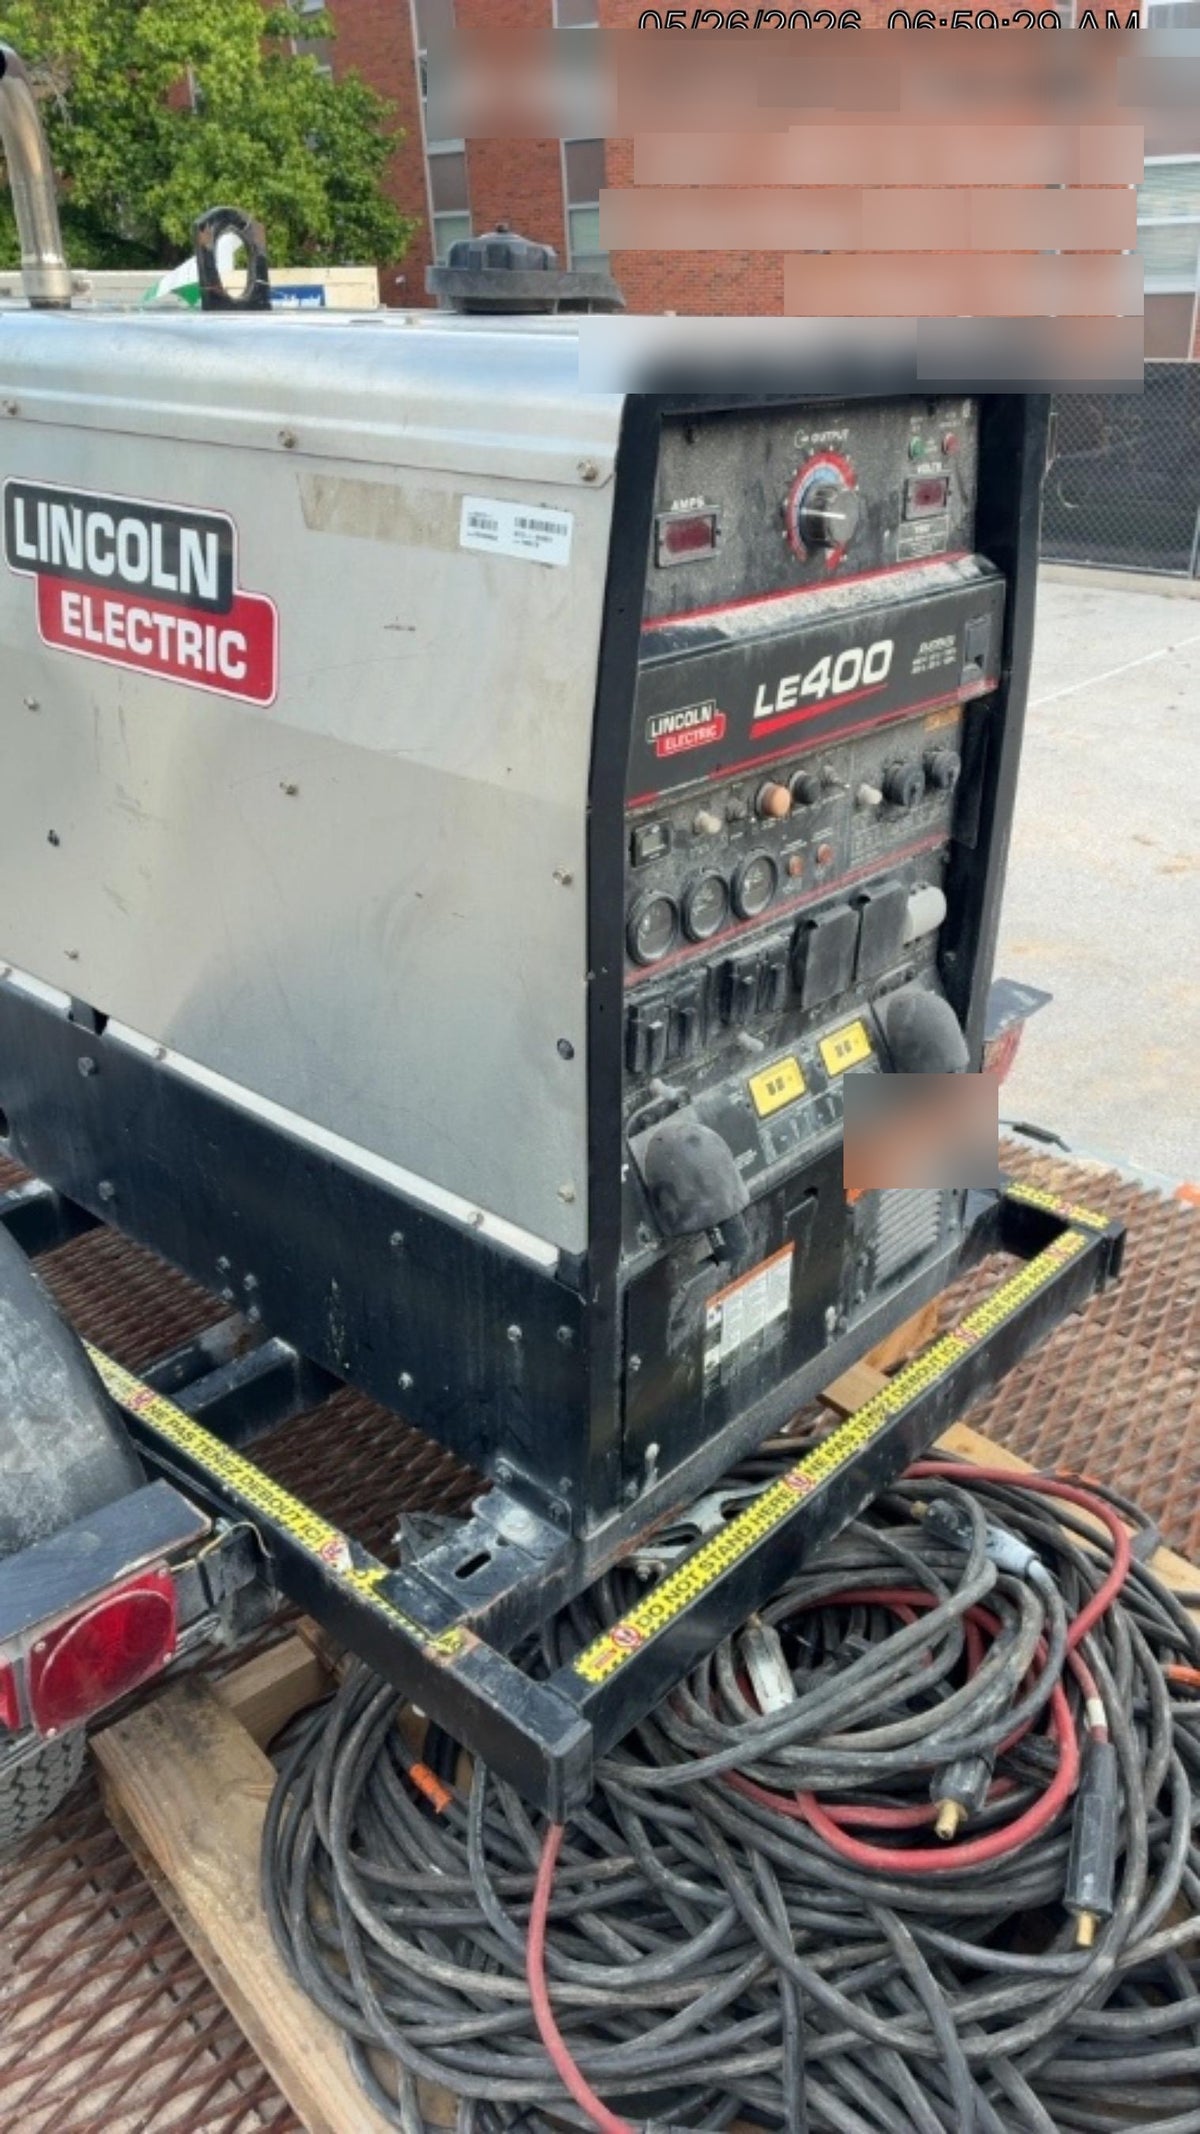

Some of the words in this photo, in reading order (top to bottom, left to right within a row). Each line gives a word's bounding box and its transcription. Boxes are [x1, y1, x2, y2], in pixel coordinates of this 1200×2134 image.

[670, 495, 705, 511] AMPS
[13, 496, 220, 600] LINCOLN
[60, 589, 247, 680] ELECTRIC
[651, 704, 713, 739] LINCOLN
[753, 639, 895, 719] LE400
[665, 724, 718, 751] ELECTRIC
[146, 1402, 169, 1423] NE
[166, 1417, 195, 1444] PAS
[193, 1438, 241, 1479] TENEZ
[238, 1472, 300, 1525] DEBOUT
[299, 1519, 325, 1543] ICI
[633, 1600, 665, 1630] DO
[661, 1569, 700, 1605] NOT
[696, 1522, 754, 1574] STAND
[749, 1485, 795, 1527] HERE
[824, 1430, 855, 1460] PAS
